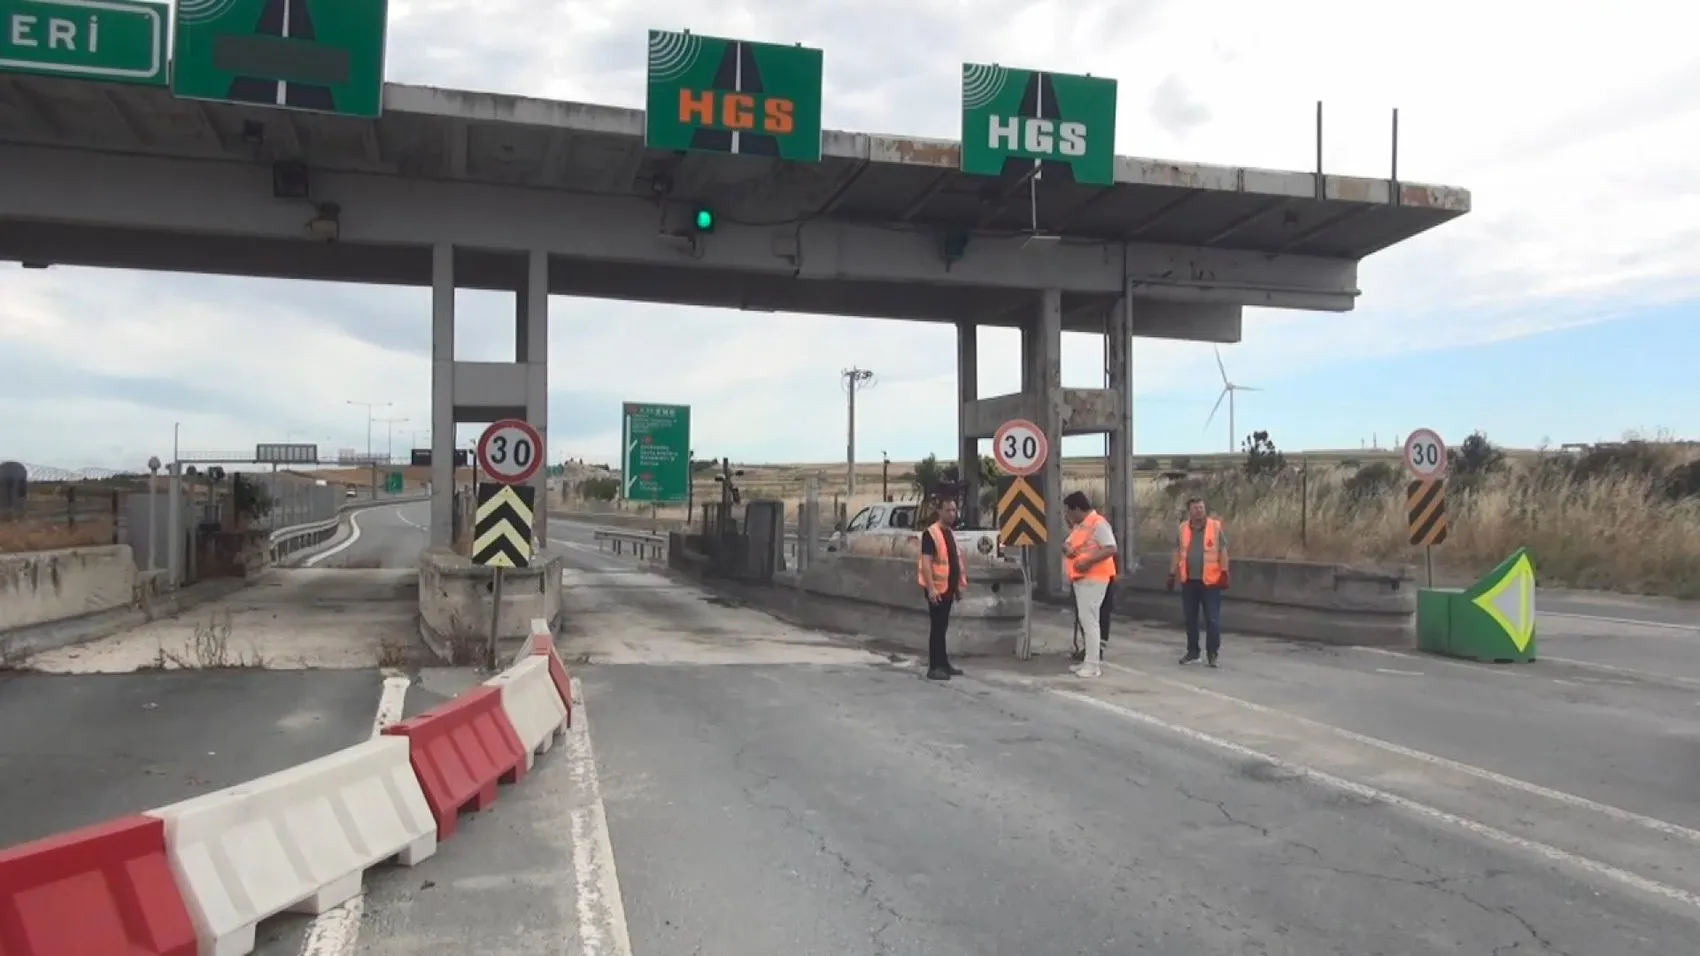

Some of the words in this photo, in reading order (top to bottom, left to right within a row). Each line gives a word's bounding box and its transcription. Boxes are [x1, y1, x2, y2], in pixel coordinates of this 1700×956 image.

[11, 15, 98, 52] ERİ
[679, 88, 794, 133] HGS
[988, 114, 1087, 156] HGS
[491, 435, 531, 467] 30
[1004, 435, 1036, 459] 30
[1412, 442, 1438, 466] 30
